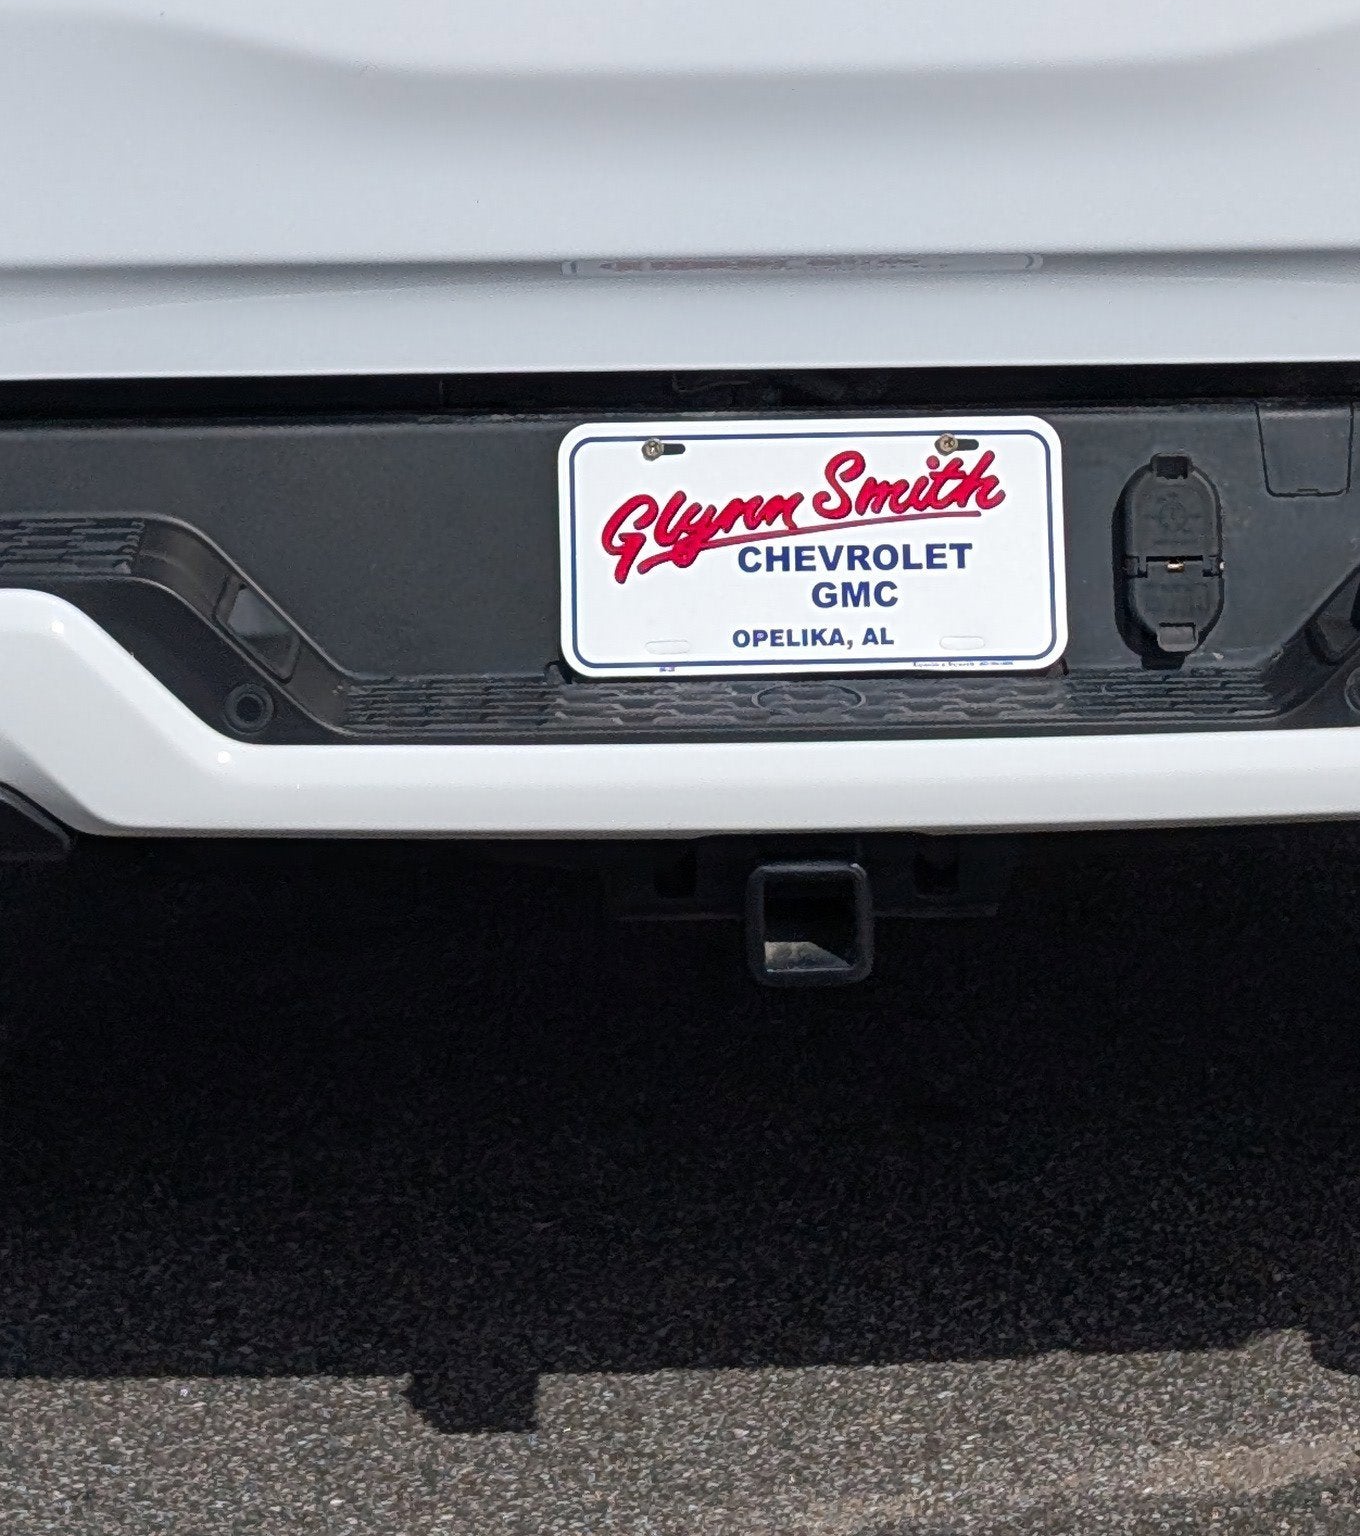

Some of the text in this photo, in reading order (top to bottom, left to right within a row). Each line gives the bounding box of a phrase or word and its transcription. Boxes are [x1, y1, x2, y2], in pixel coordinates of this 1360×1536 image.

[600, 449, 1007, 585] Glynn Smith
[738, 541, 974, 573] CHEVROLET
[810, 579, 900, 610] GMC
[731, 626, 895, 652] OPELIKA, AL
